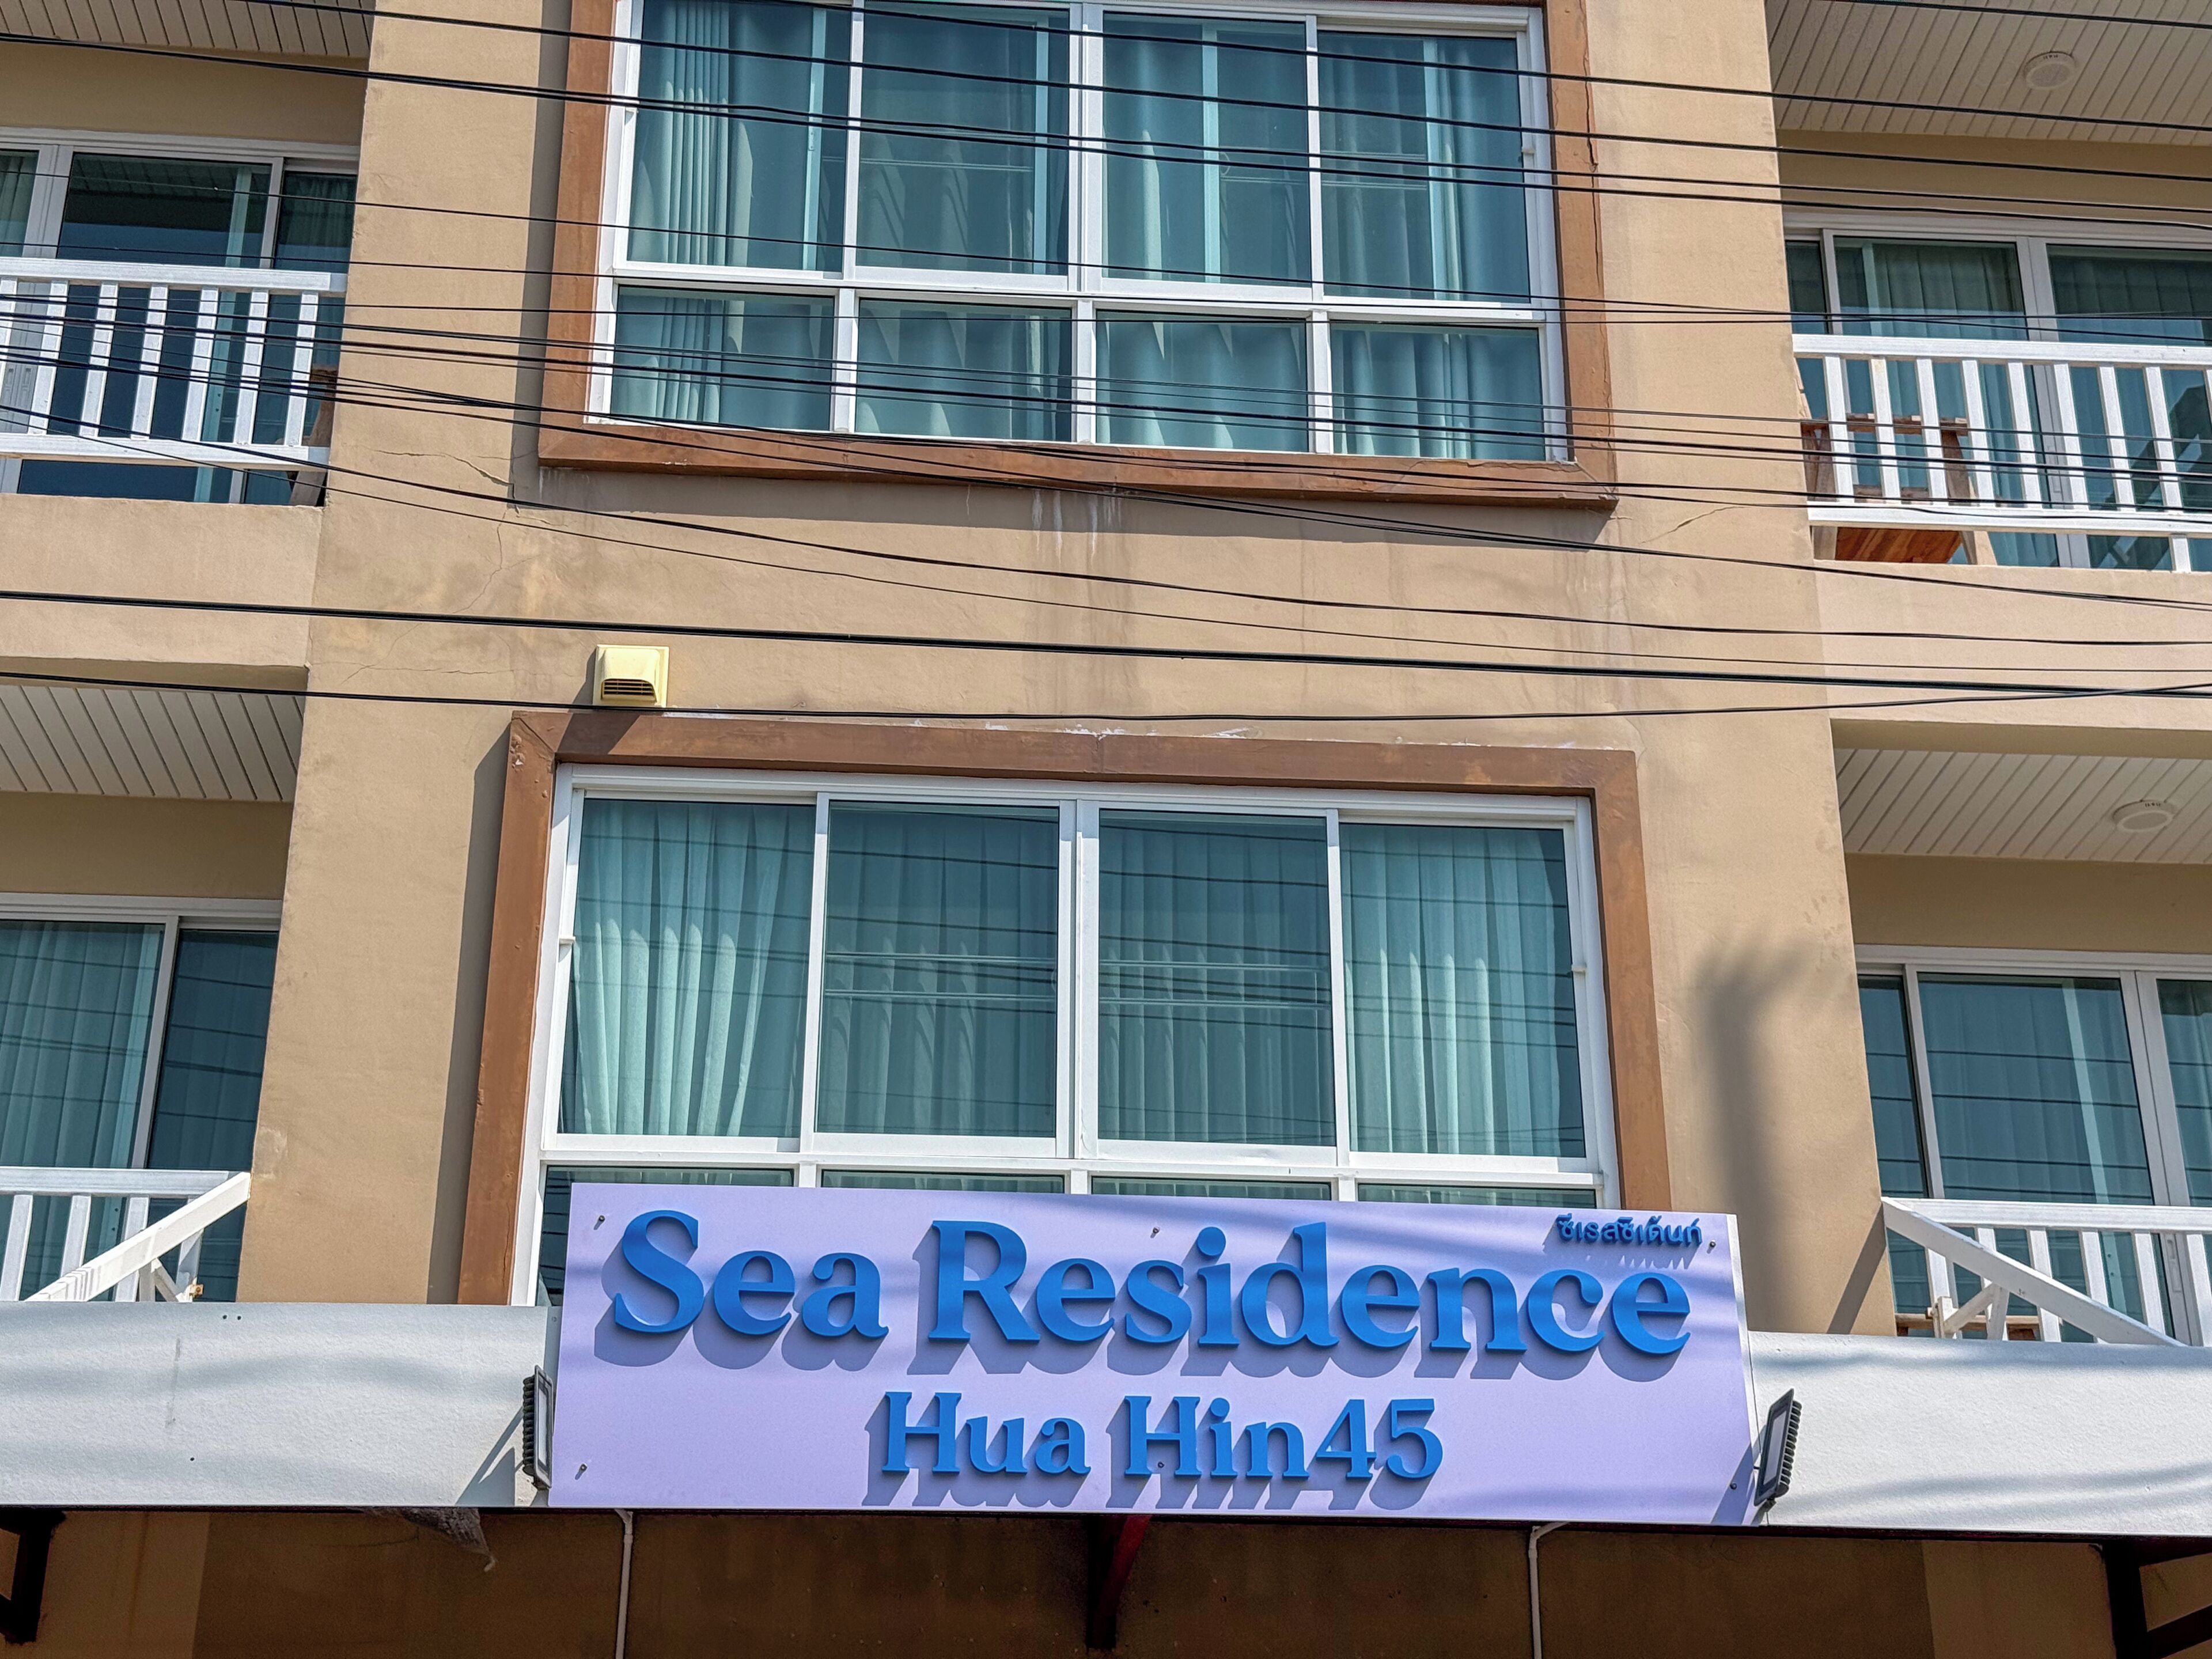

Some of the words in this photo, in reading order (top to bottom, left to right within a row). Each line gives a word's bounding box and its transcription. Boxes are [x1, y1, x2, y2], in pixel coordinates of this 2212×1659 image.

[612, 1210, 889, 1341] Sea
[927, 1220, 1691, 1358] Residence
[881, 1391, 1092, 1478] Hua
[1123, 1396, 1443, 1483] Hin45
